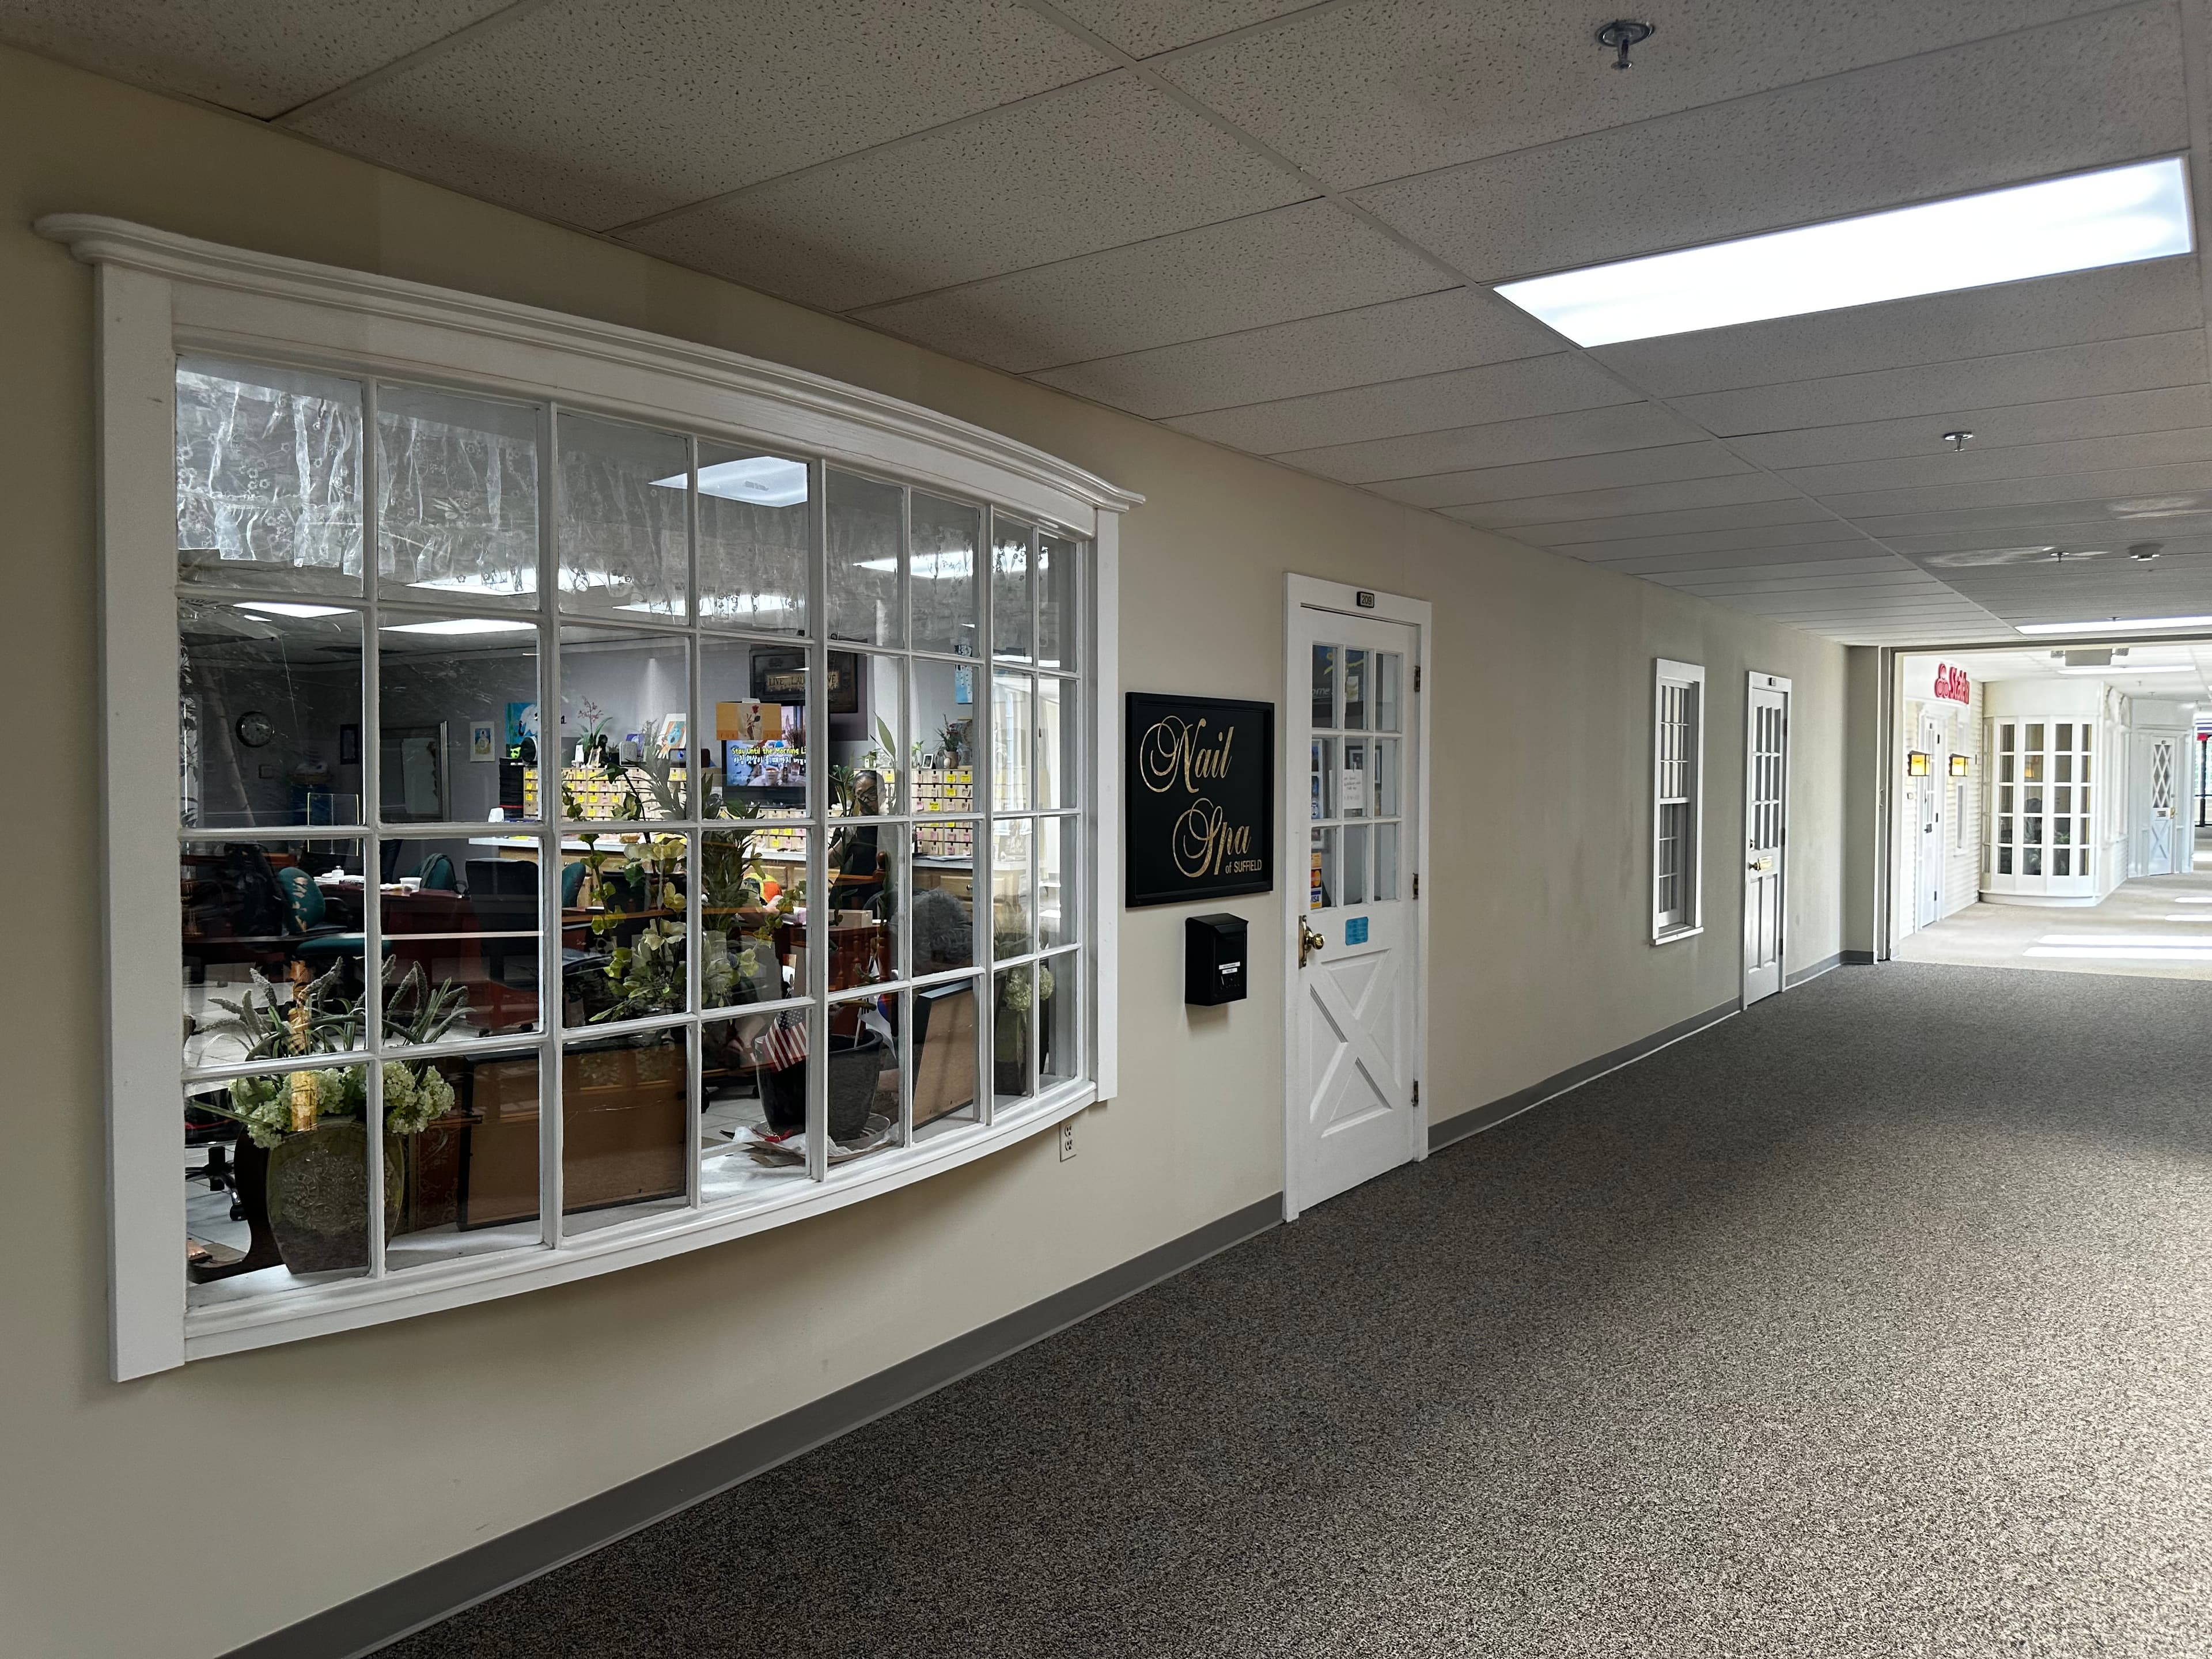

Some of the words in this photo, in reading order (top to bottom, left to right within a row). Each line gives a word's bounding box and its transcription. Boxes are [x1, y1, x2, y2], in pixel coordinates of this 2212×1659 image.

[1361, 594, 1372, 605] 209
[1140, 715, 1234, 793] Nail
[1173, 797, 1252, 878] Spa
[1225, 862, 1232, 874] of
[1234, 859, 1262, 873] SUFFIELD
